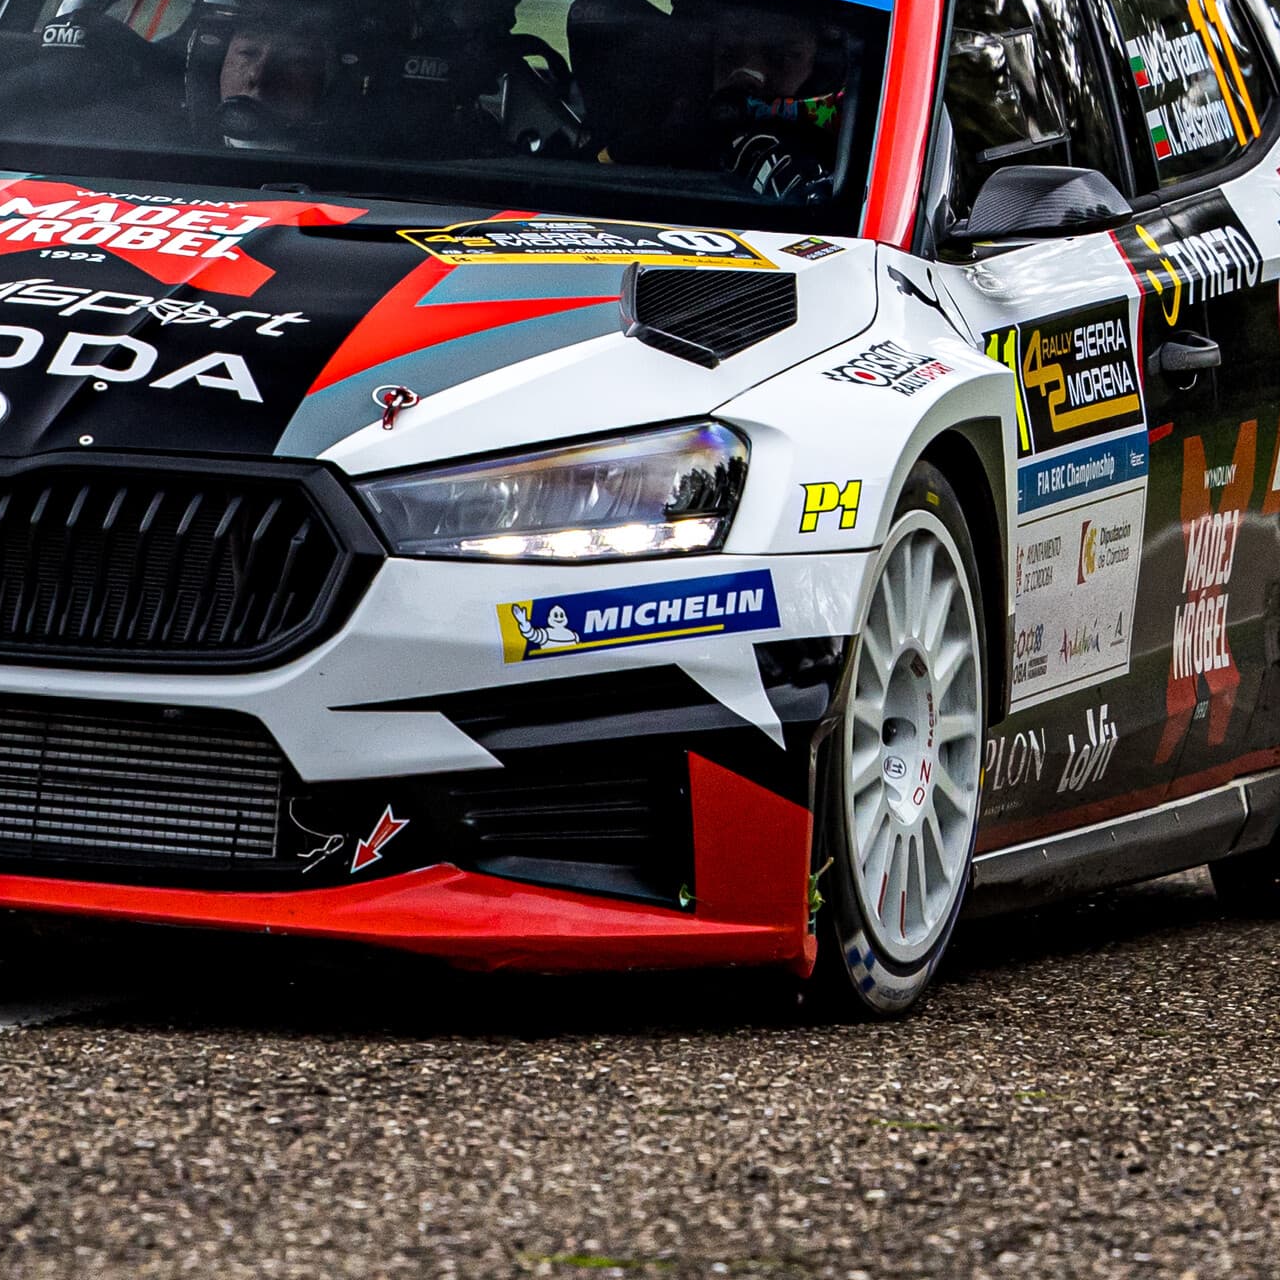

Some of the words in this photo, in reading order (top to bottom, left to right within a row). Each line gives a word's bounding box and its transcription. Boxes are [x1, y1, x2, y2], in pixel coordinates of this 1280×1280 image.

[75, 190, 249, 209] WYNDLINY
[38, 248, 107, 264] 1992
[1041, 331, 1073, 361] RALLY
[1073, 318, 1128, 361] SIERRA
[1066, 360, 1136, 407] MORENA
[1036, 470, 1050, 497] FIA
[1051, 465, 1066, 492] ERC
[1066, 451, 1116, 488] Championship
[798, 478, 863, 534] P1
[1182, 509, 1240, 594] MADEJ
[583, 587, 766, 635] MICHELIN
[1172, 590, 1231, 681] WRÓBEL
